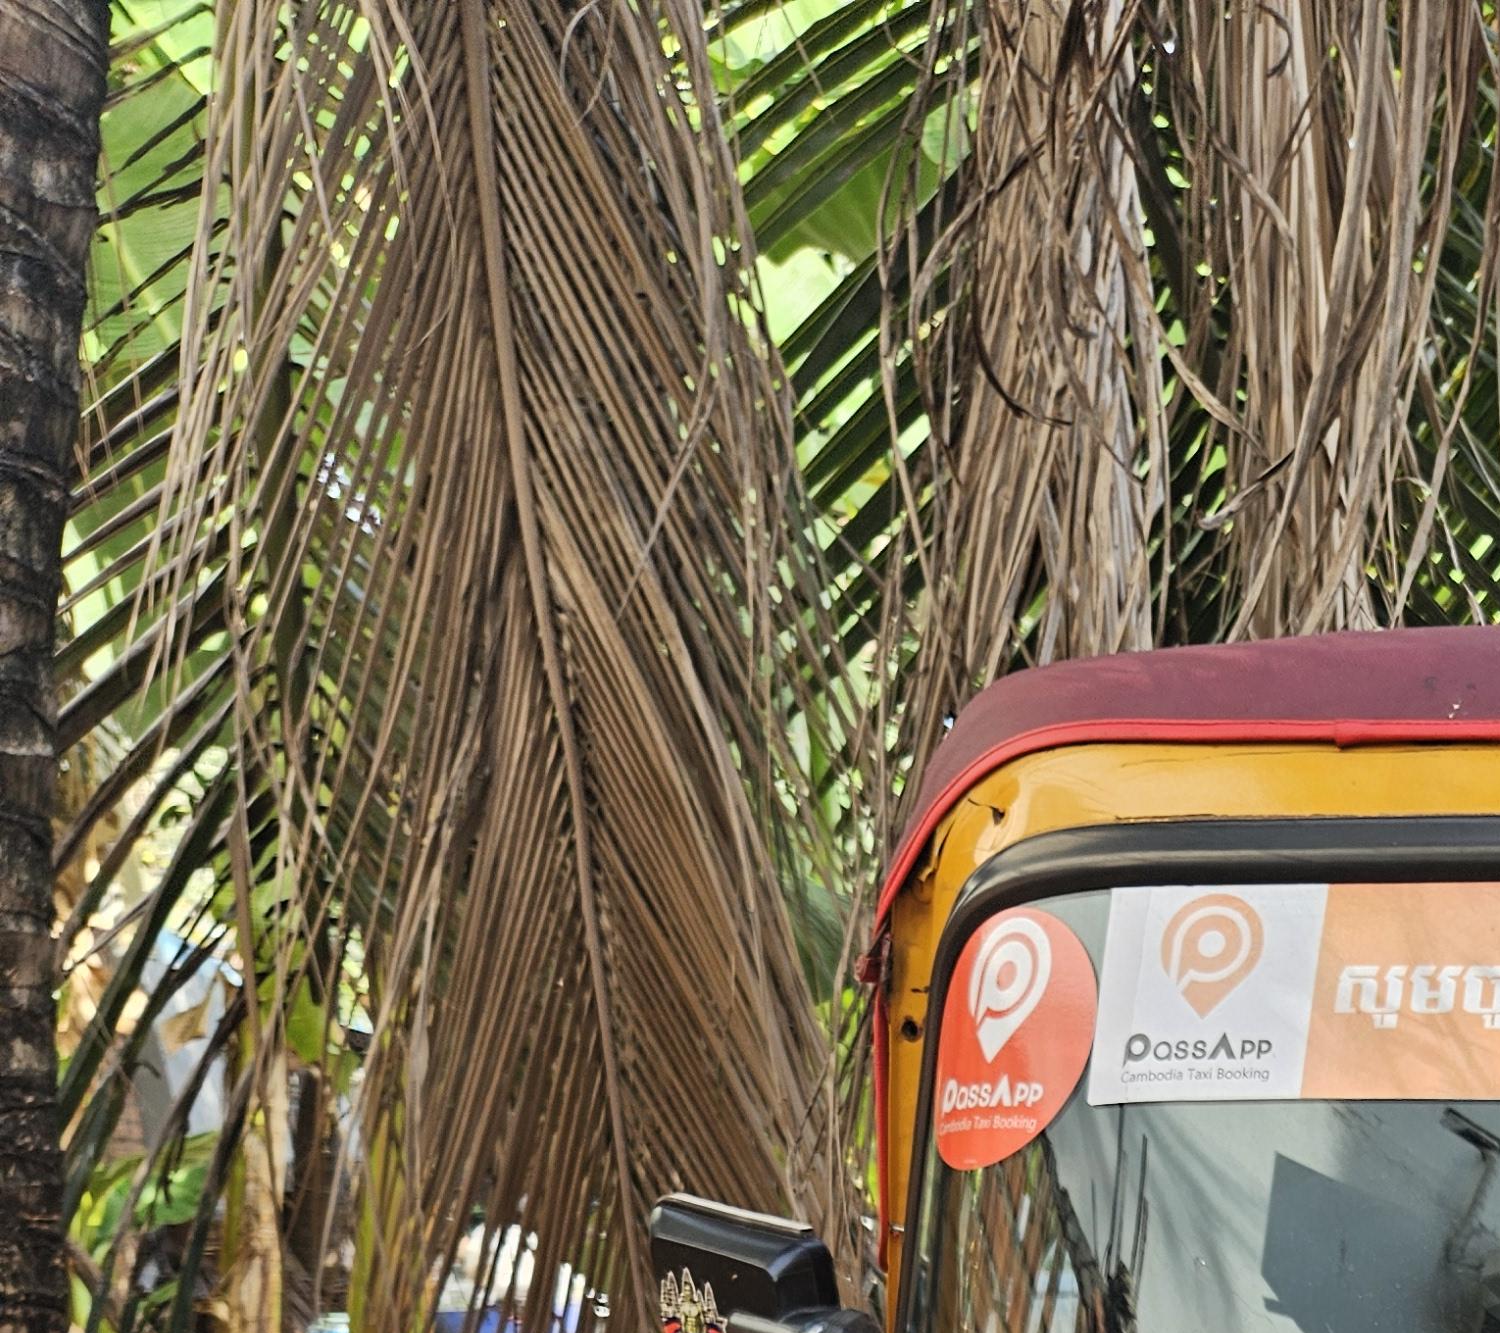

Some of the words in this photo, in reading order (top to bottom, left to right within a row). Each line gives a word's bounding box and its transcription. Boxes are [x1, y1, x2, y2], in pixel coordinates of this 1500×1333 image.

[1122, 1031, 1274, 1067] PassApp
[1120, 1068, 1184, 1084] Cambodia
[1187, 1067, 1213, 1081] Taxi
[1216, 1067, 1271, 1083] Booking
[941, 1073, 1046, 1118] PassApp
[992, 1114, 1038, 1134] Booking
